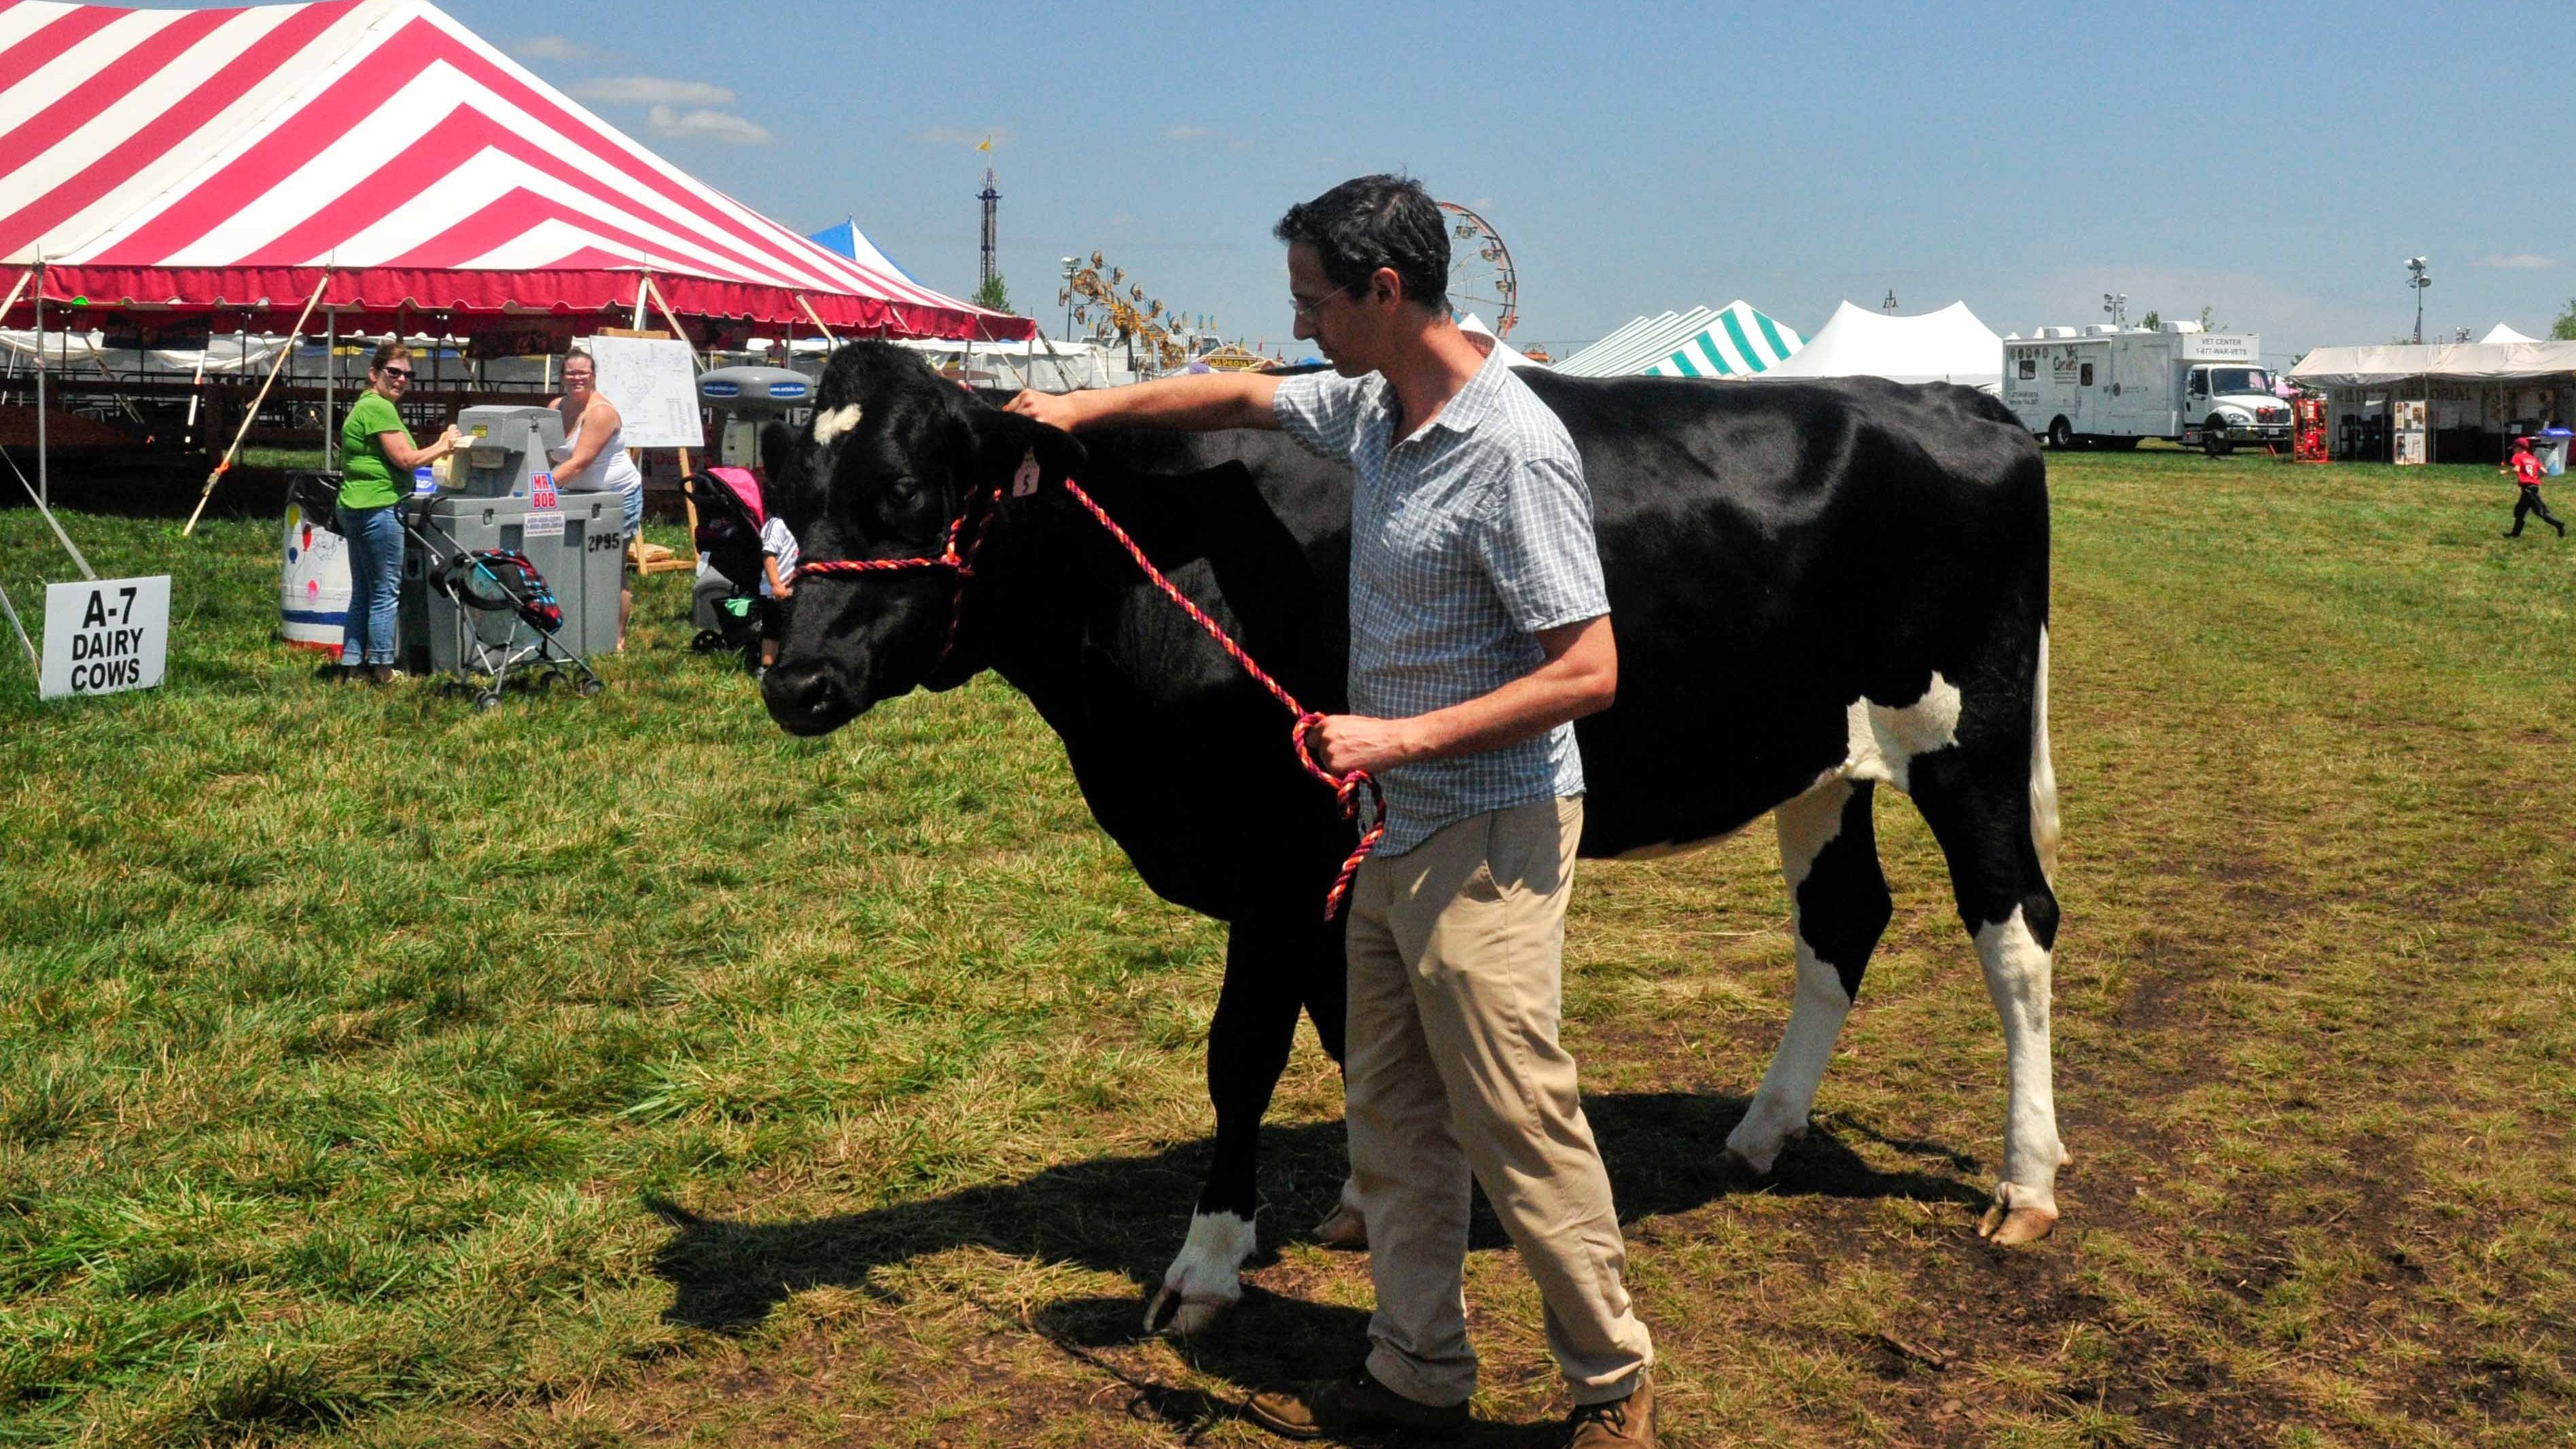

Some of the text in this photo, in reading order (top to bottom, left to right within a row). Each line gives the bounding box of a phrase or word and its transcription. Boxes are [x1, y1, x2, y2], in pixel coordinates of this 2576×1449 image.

[533, 474, 552, 491] MR.
[533, 492, 556, 508] BOB
[588, 532, 620, 553] 2P95
[82, 587, 137, 629] A-7
[72, 627, 145, 661] DAIRY
[71, 658, 140, 692] COWS
